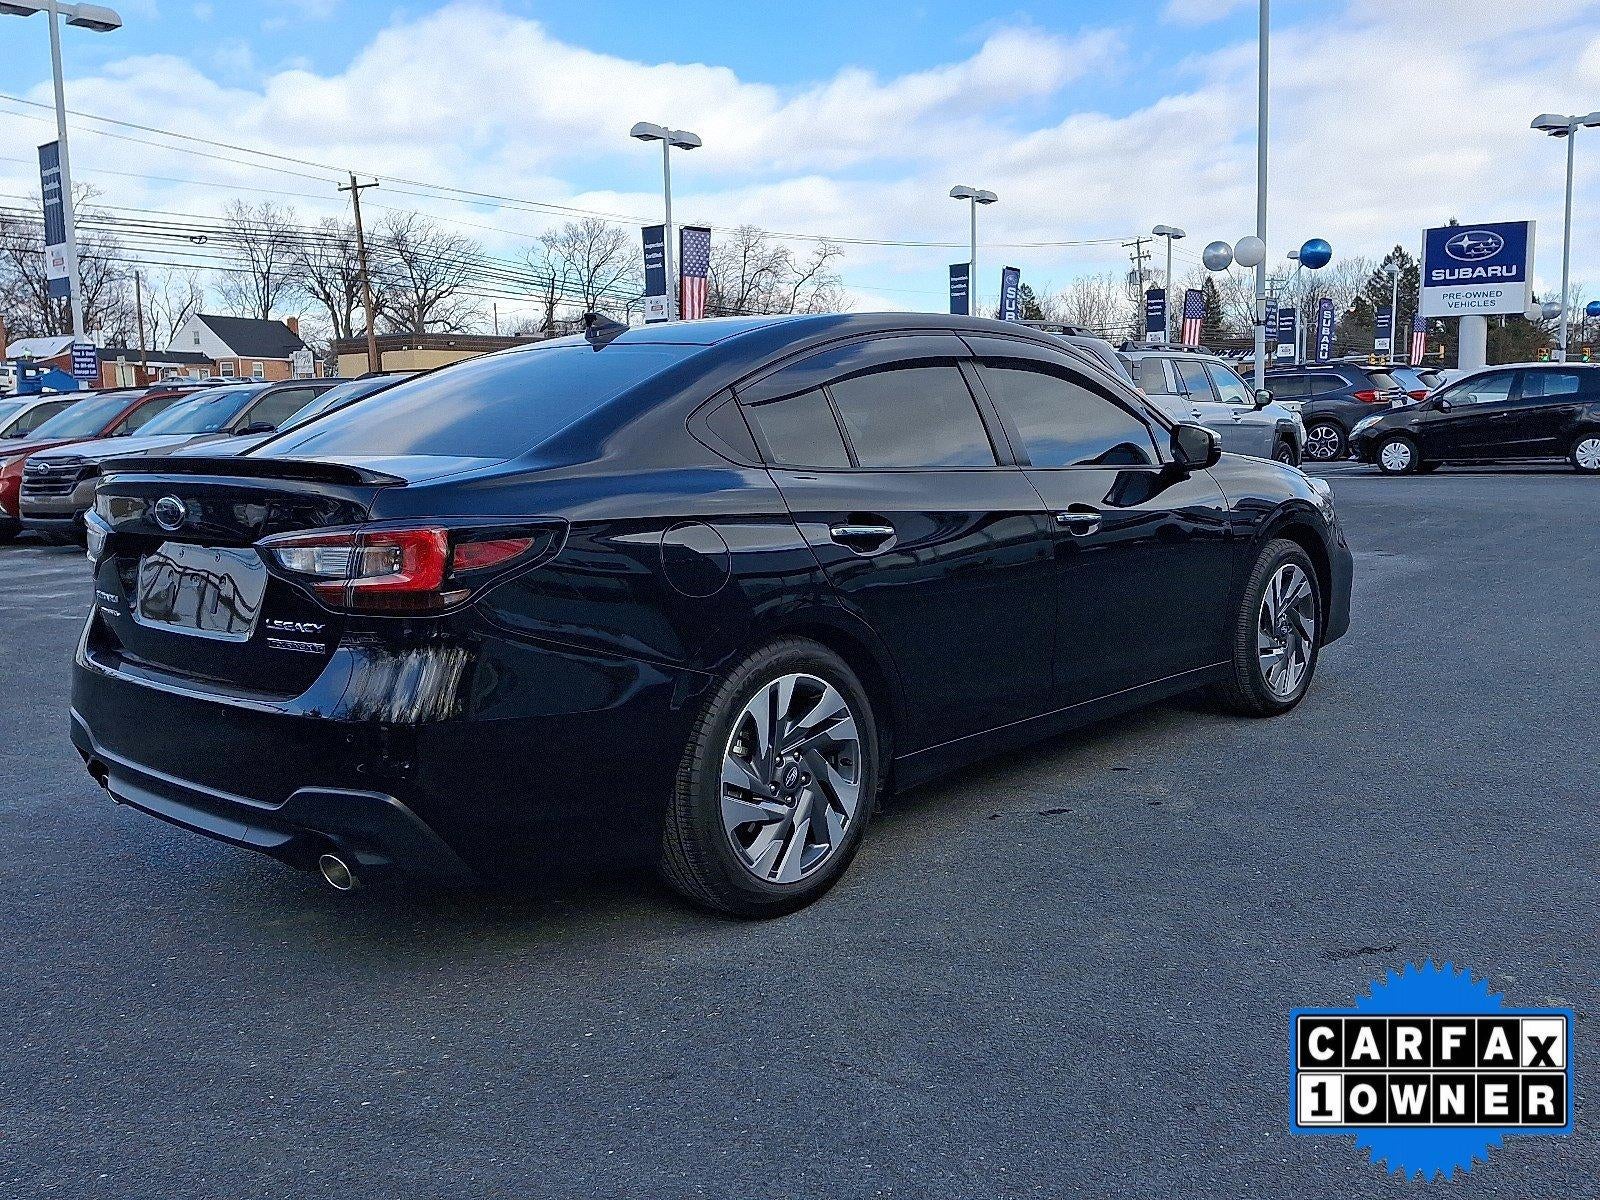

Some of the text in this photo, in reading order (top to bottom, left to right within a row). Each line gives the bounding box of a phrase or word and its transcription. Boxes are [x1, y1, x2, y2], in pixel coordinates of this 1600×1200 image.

[1431, 264, 1517, 281] SUBARU
[1442, 290, 1503, 300] PRE-OWNED
[1447, 300, 1496, 308] VEHICLES
[1319, 310, 1332, 360] SUBARU
[265, 618, 326, 633] LEGACY
